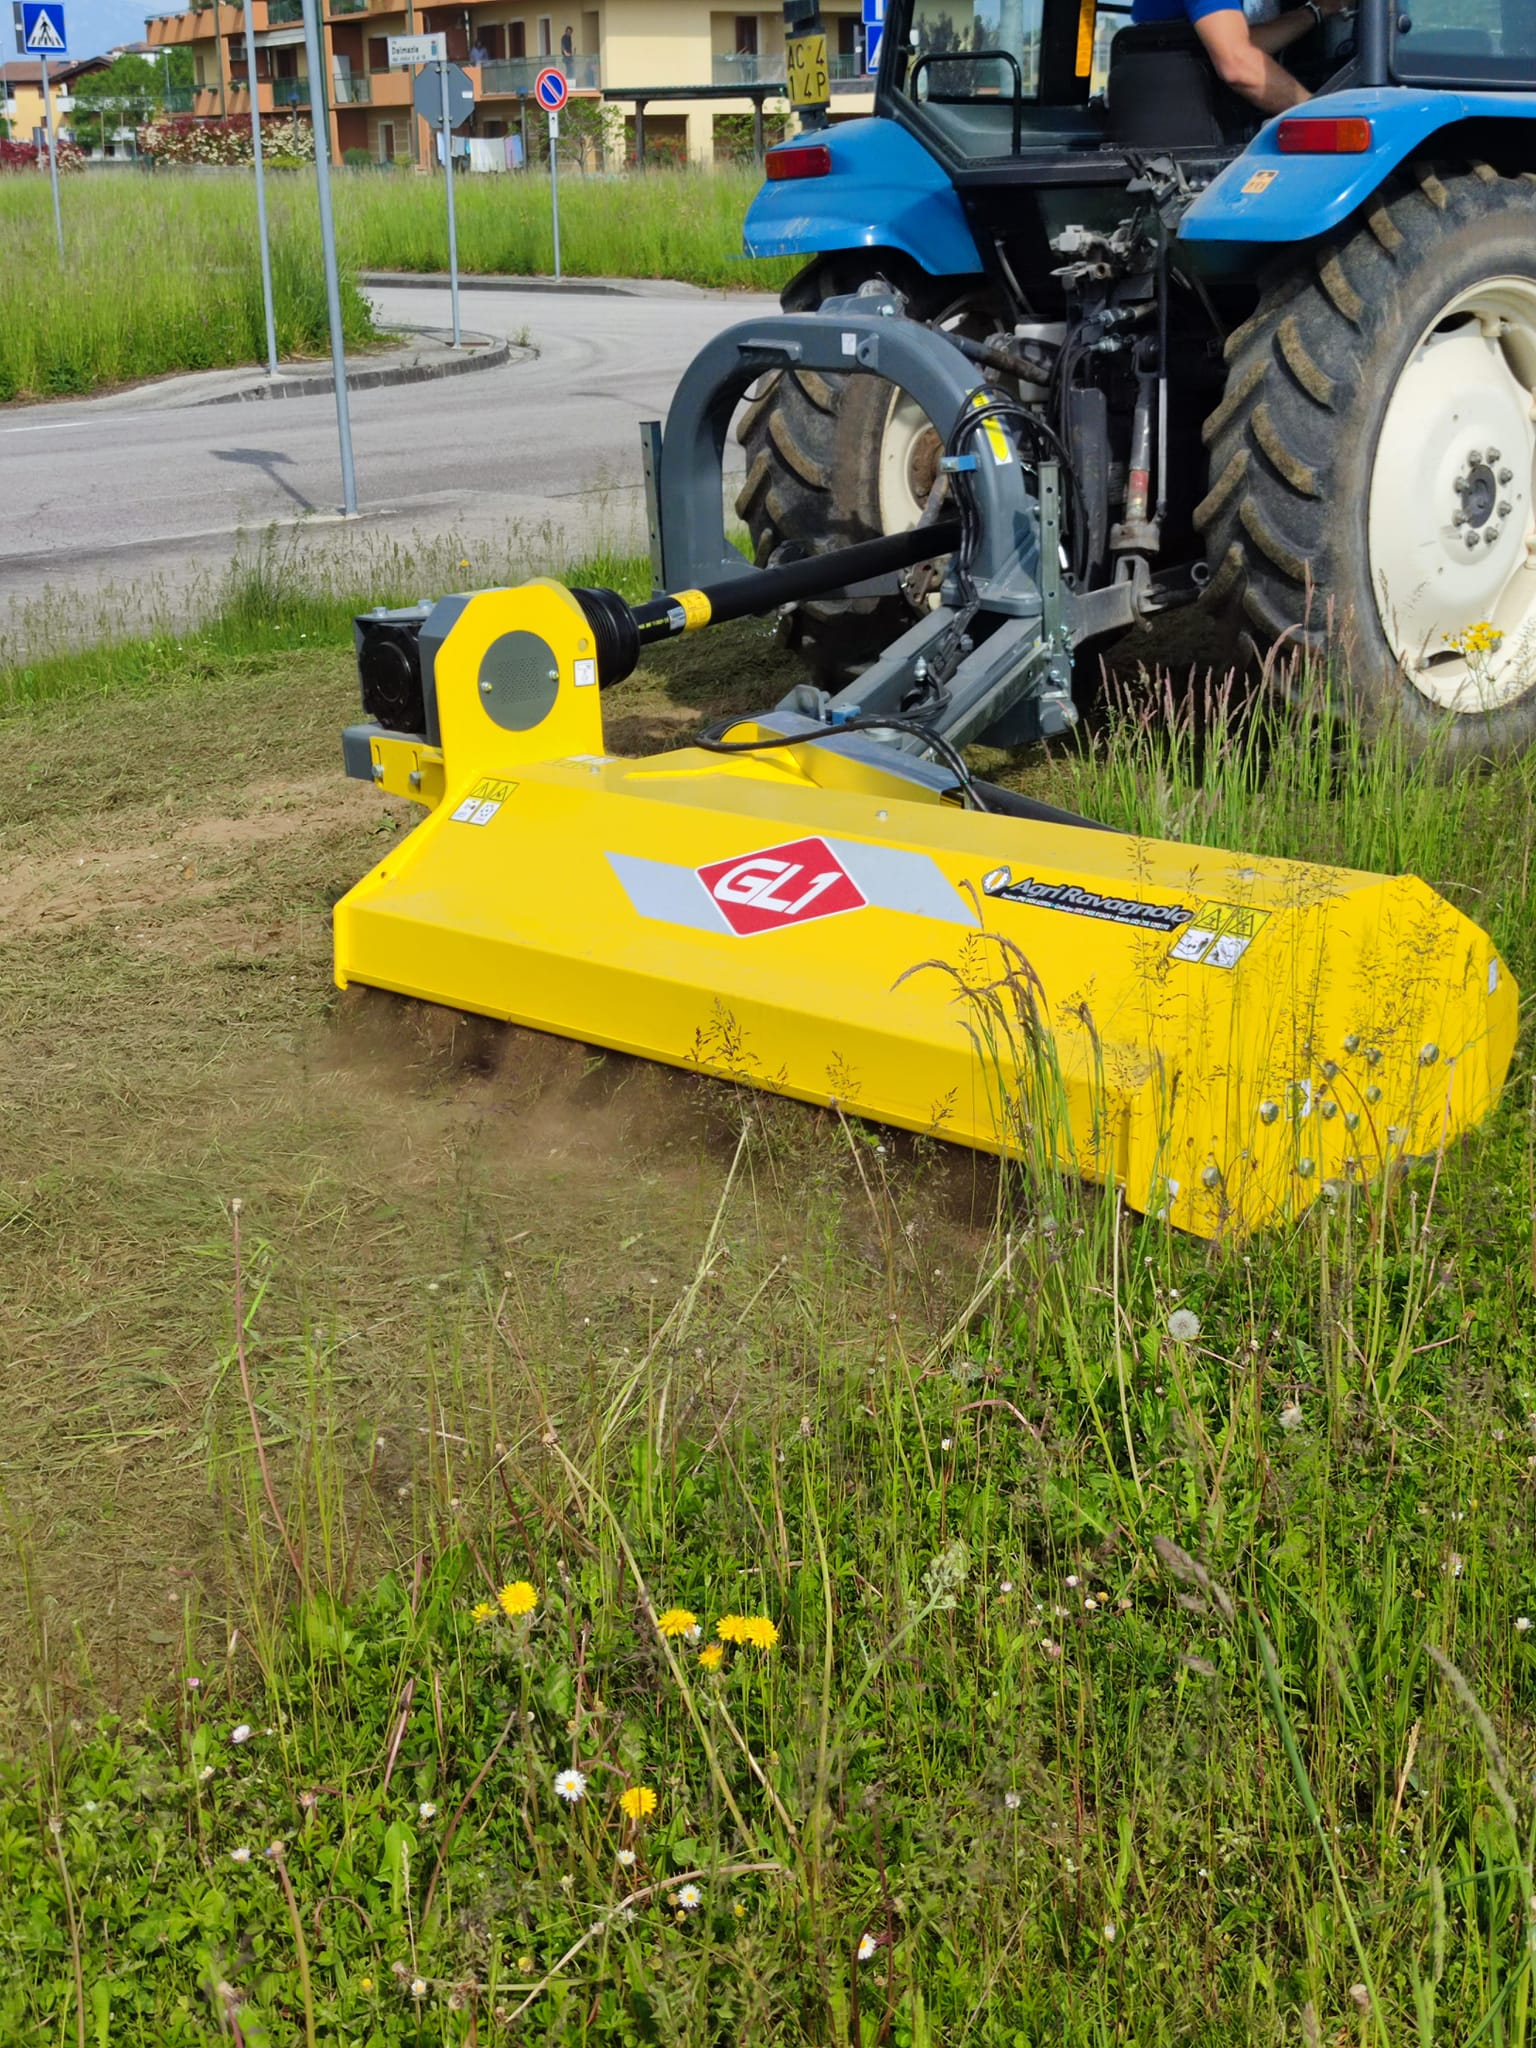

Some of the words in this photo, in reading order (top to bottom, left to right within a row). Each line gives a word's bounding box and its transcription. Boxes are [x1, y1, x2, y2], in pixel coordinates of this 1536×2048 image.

[788, 44, 805, 70] AC
[713, 858, 843, 915] GL1
[1010, 878, 1064, 898] Agri
[1059, 886, 1192, 922] Ravagnolo
